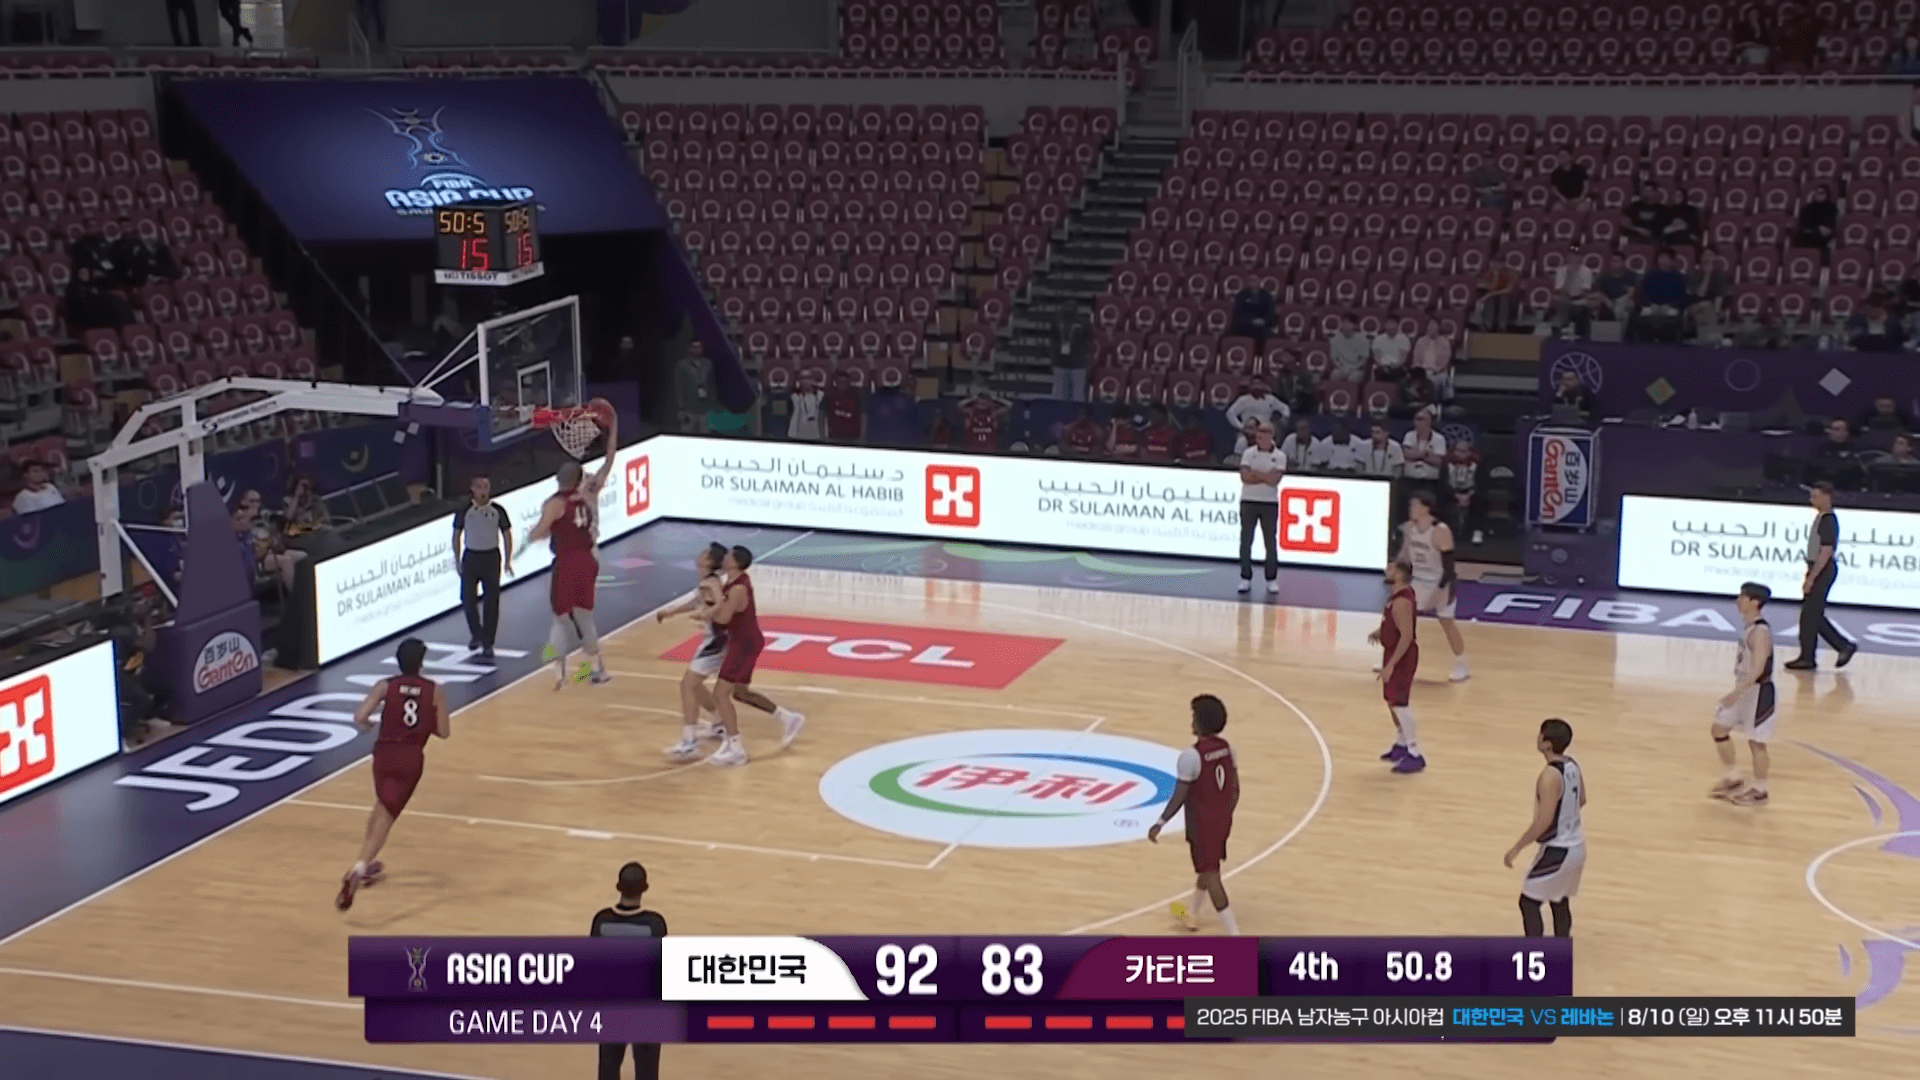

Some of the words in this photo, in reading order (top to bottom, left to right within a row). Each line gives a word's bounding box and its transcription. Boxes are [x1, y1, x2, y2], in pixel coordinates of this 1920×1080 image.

[385, 189, 464, 207] ASIA
[439, 211, 485, 234] 50:5
[461, 238, 489, 272] 15
[701, 474, 725, 489] DR
[730, 475, 820, 496] SULAIMAN
[825, 483, 846, 499] AL
[852, 485, 904, 502] HABIB
[1038, 498, 1063, 513] DR
[1069, 499, 1166, 520] SULAIMAN
[1171, 507, 1194, 523] AL
[1200, 509, 1239, 525] HAB
[1670, 539, 1700, 556] DR
[1708, 541, 1808, 563] SULAIMA
[337, 597, 353, 617] DR
[356, 575, 411, 609] SULAIMAN
[413, 570, 425, 586] AL
[1484, 593, 1737, 633] FIBA
[762, 630, 976, 669] TCL
[403, 698, 418, 727] 8
[913, 763, 1140, 807] 伊利
[1215, 763, 1225, 791] 0
